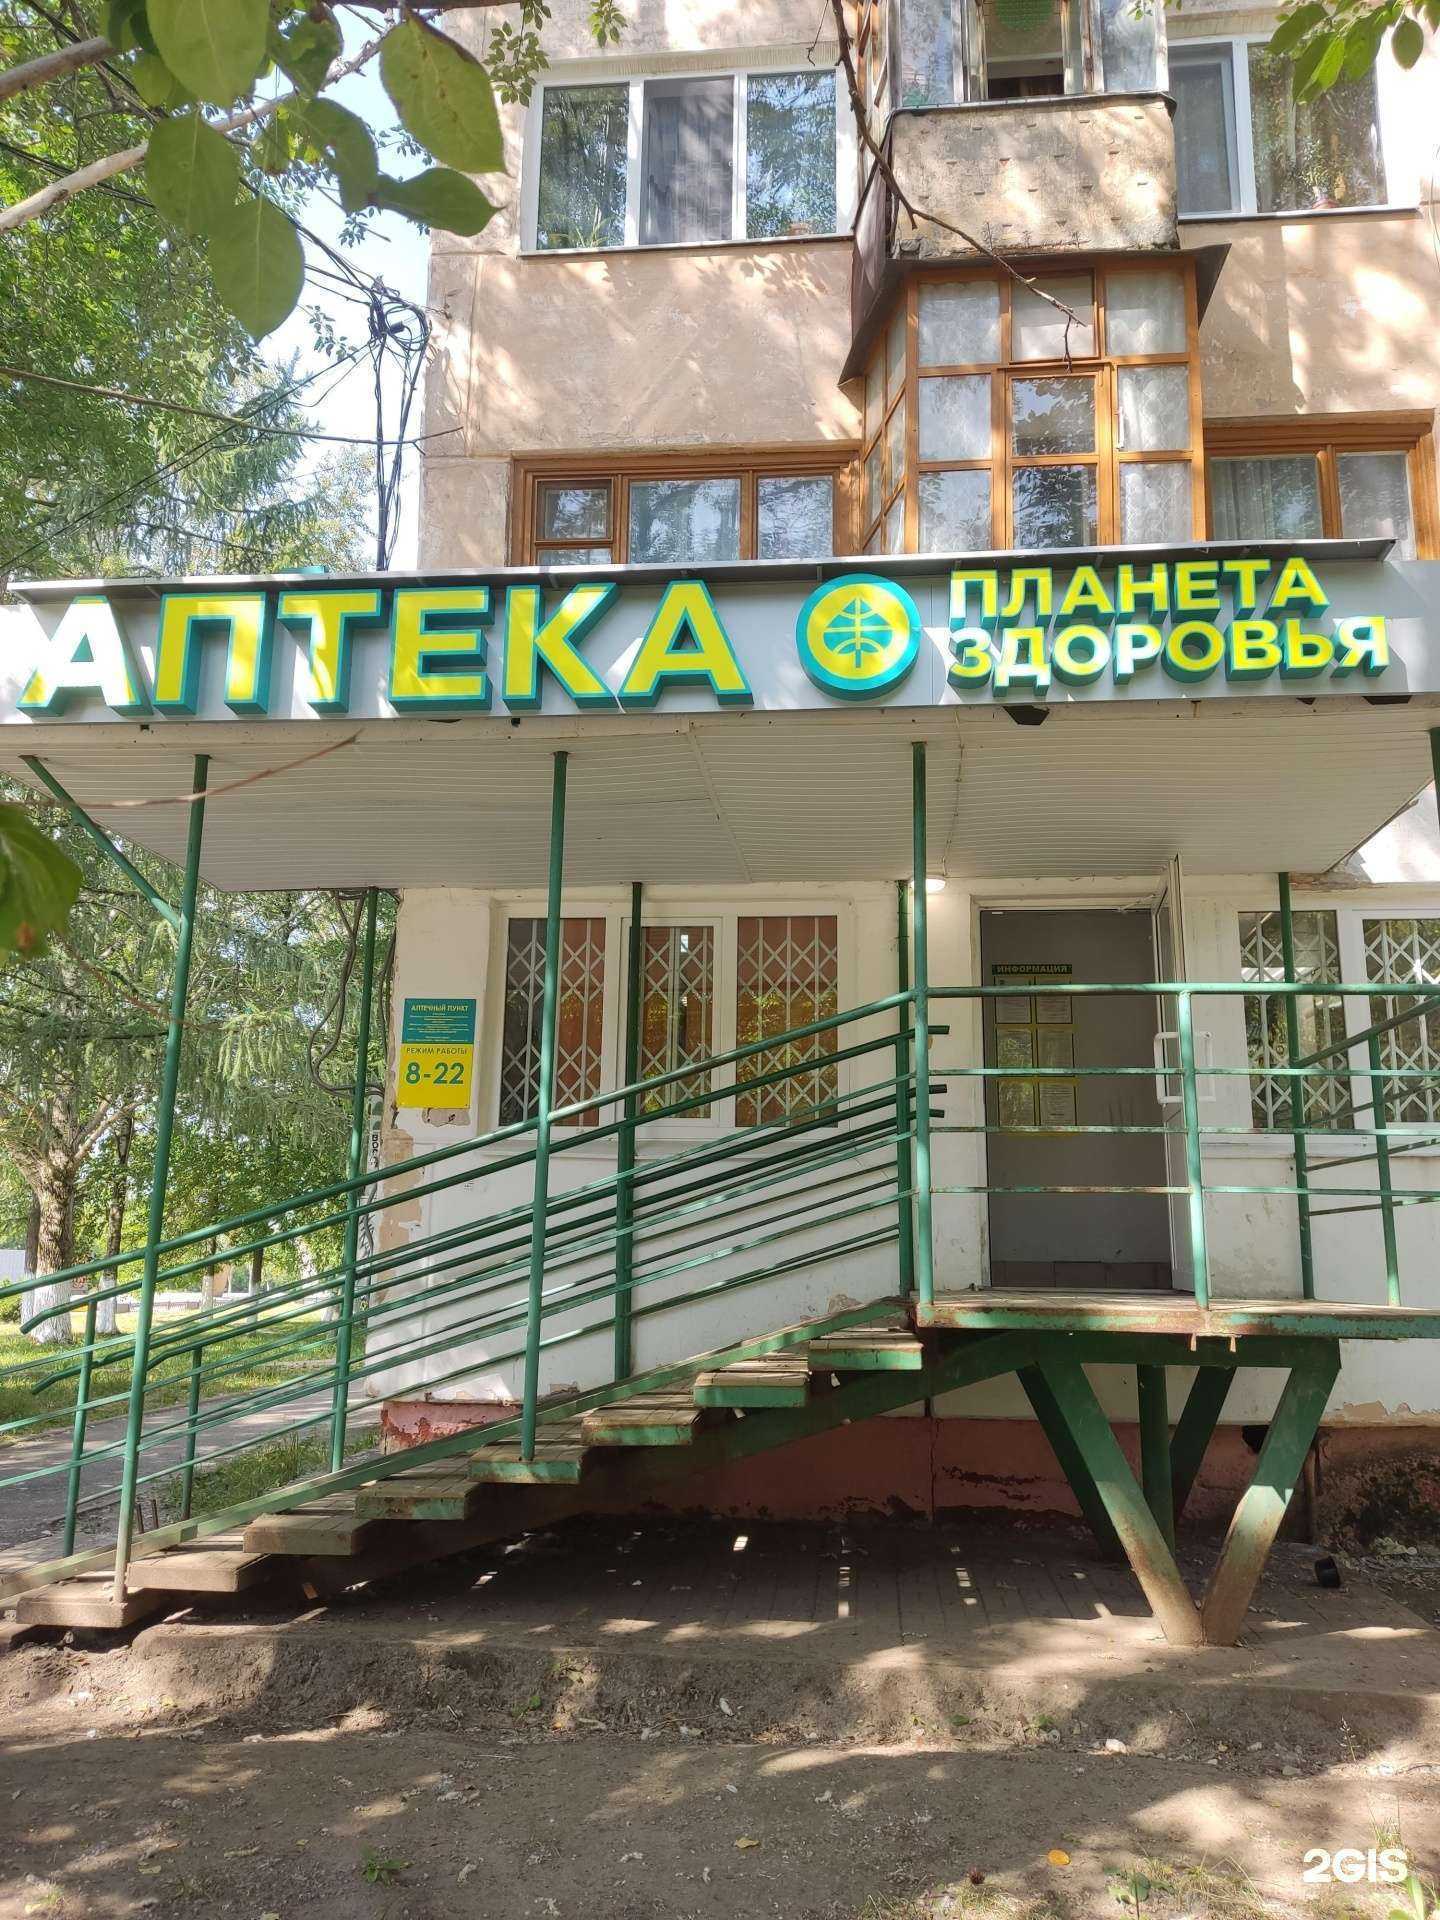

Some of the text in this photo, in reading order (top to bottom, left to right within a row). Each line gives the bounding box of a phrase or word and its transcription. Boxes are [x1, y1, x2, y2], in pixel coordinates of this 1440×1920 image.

[948, 556, 1330, 627] ПЛАНЕТА
[15, 578, 756, 717] АПТЕКА
[947, 615, 1392, 697] ЗДОРОВЬЯ
[997, 965, 1068, 974] ИНФОРМАЦИЯ
[410, 1003, 446, 1012] АПТЕЧНЫЙ
[406, 1047, 468, 1056] РЕЖИМ РАБОТЫ
